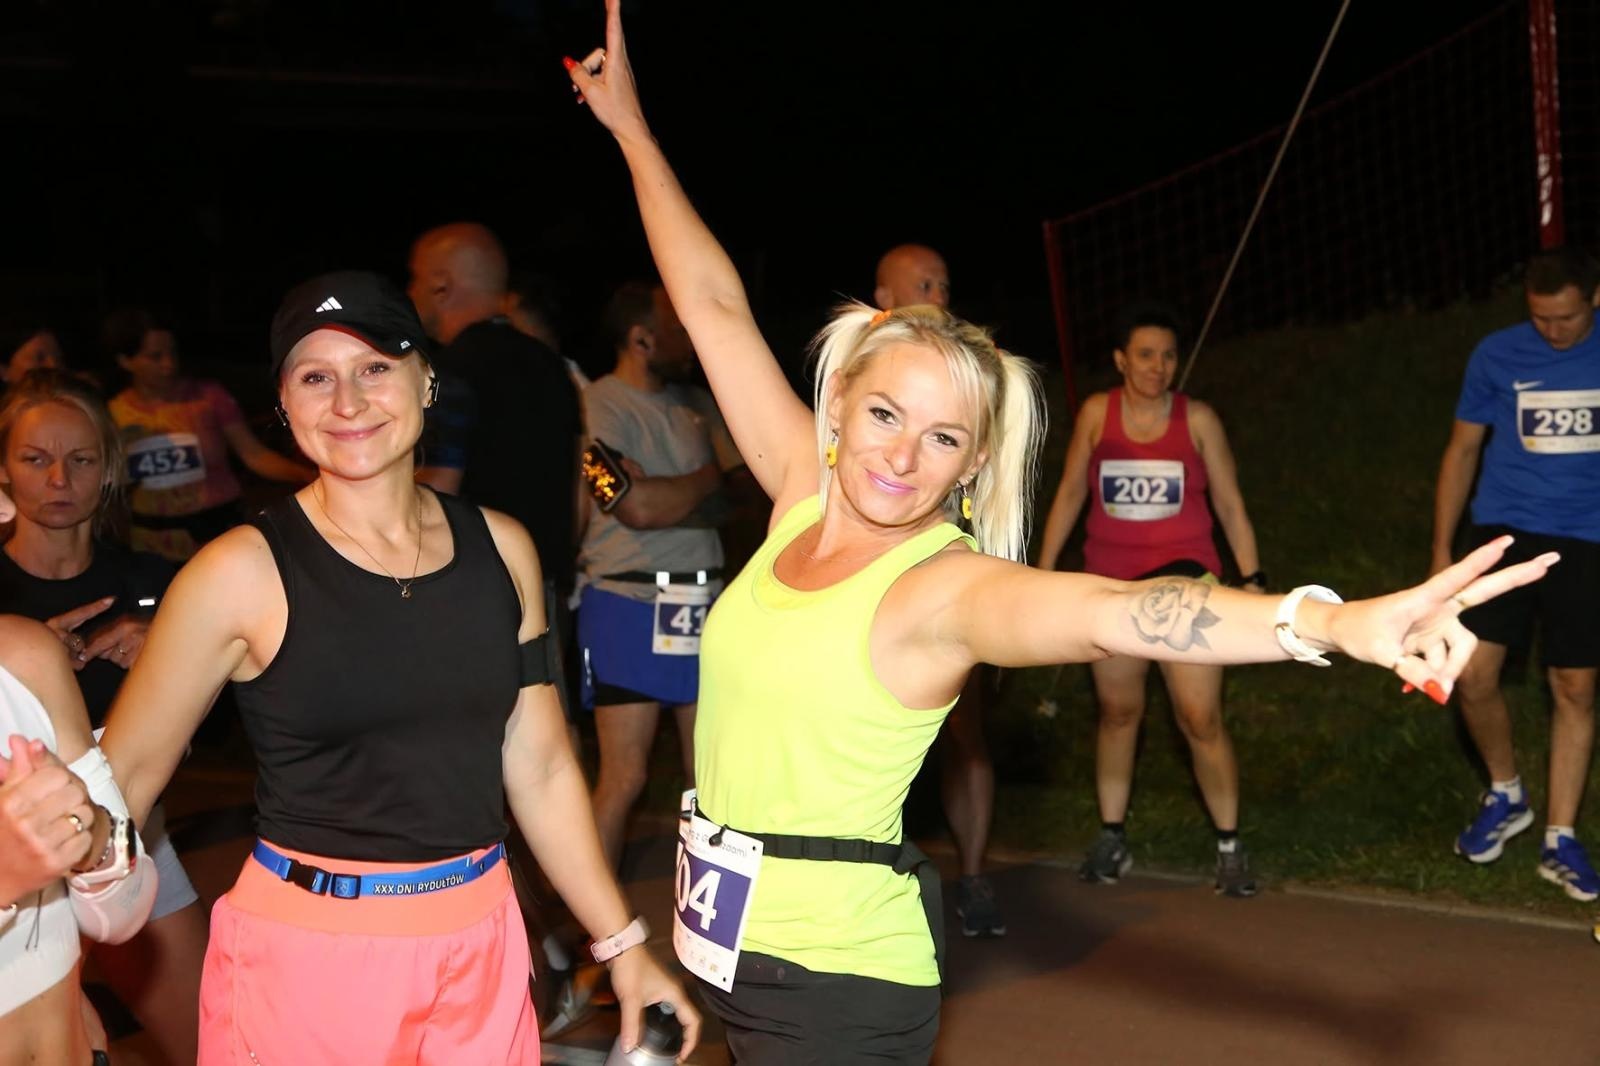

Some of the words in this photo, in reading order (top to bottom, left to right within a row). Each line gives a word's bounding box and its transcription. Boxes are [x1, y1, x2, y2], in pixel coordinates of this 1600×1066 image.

[1534, 408, 1593, 435] 298
[138, 447, 191, 474] 452
[1114, 477, 1168, 503] 202
[374, 883, 395, 895] XXX
[396, 883, 415, 895] DNI
[417, 873, 465, 893] RYDUŁTÓW
